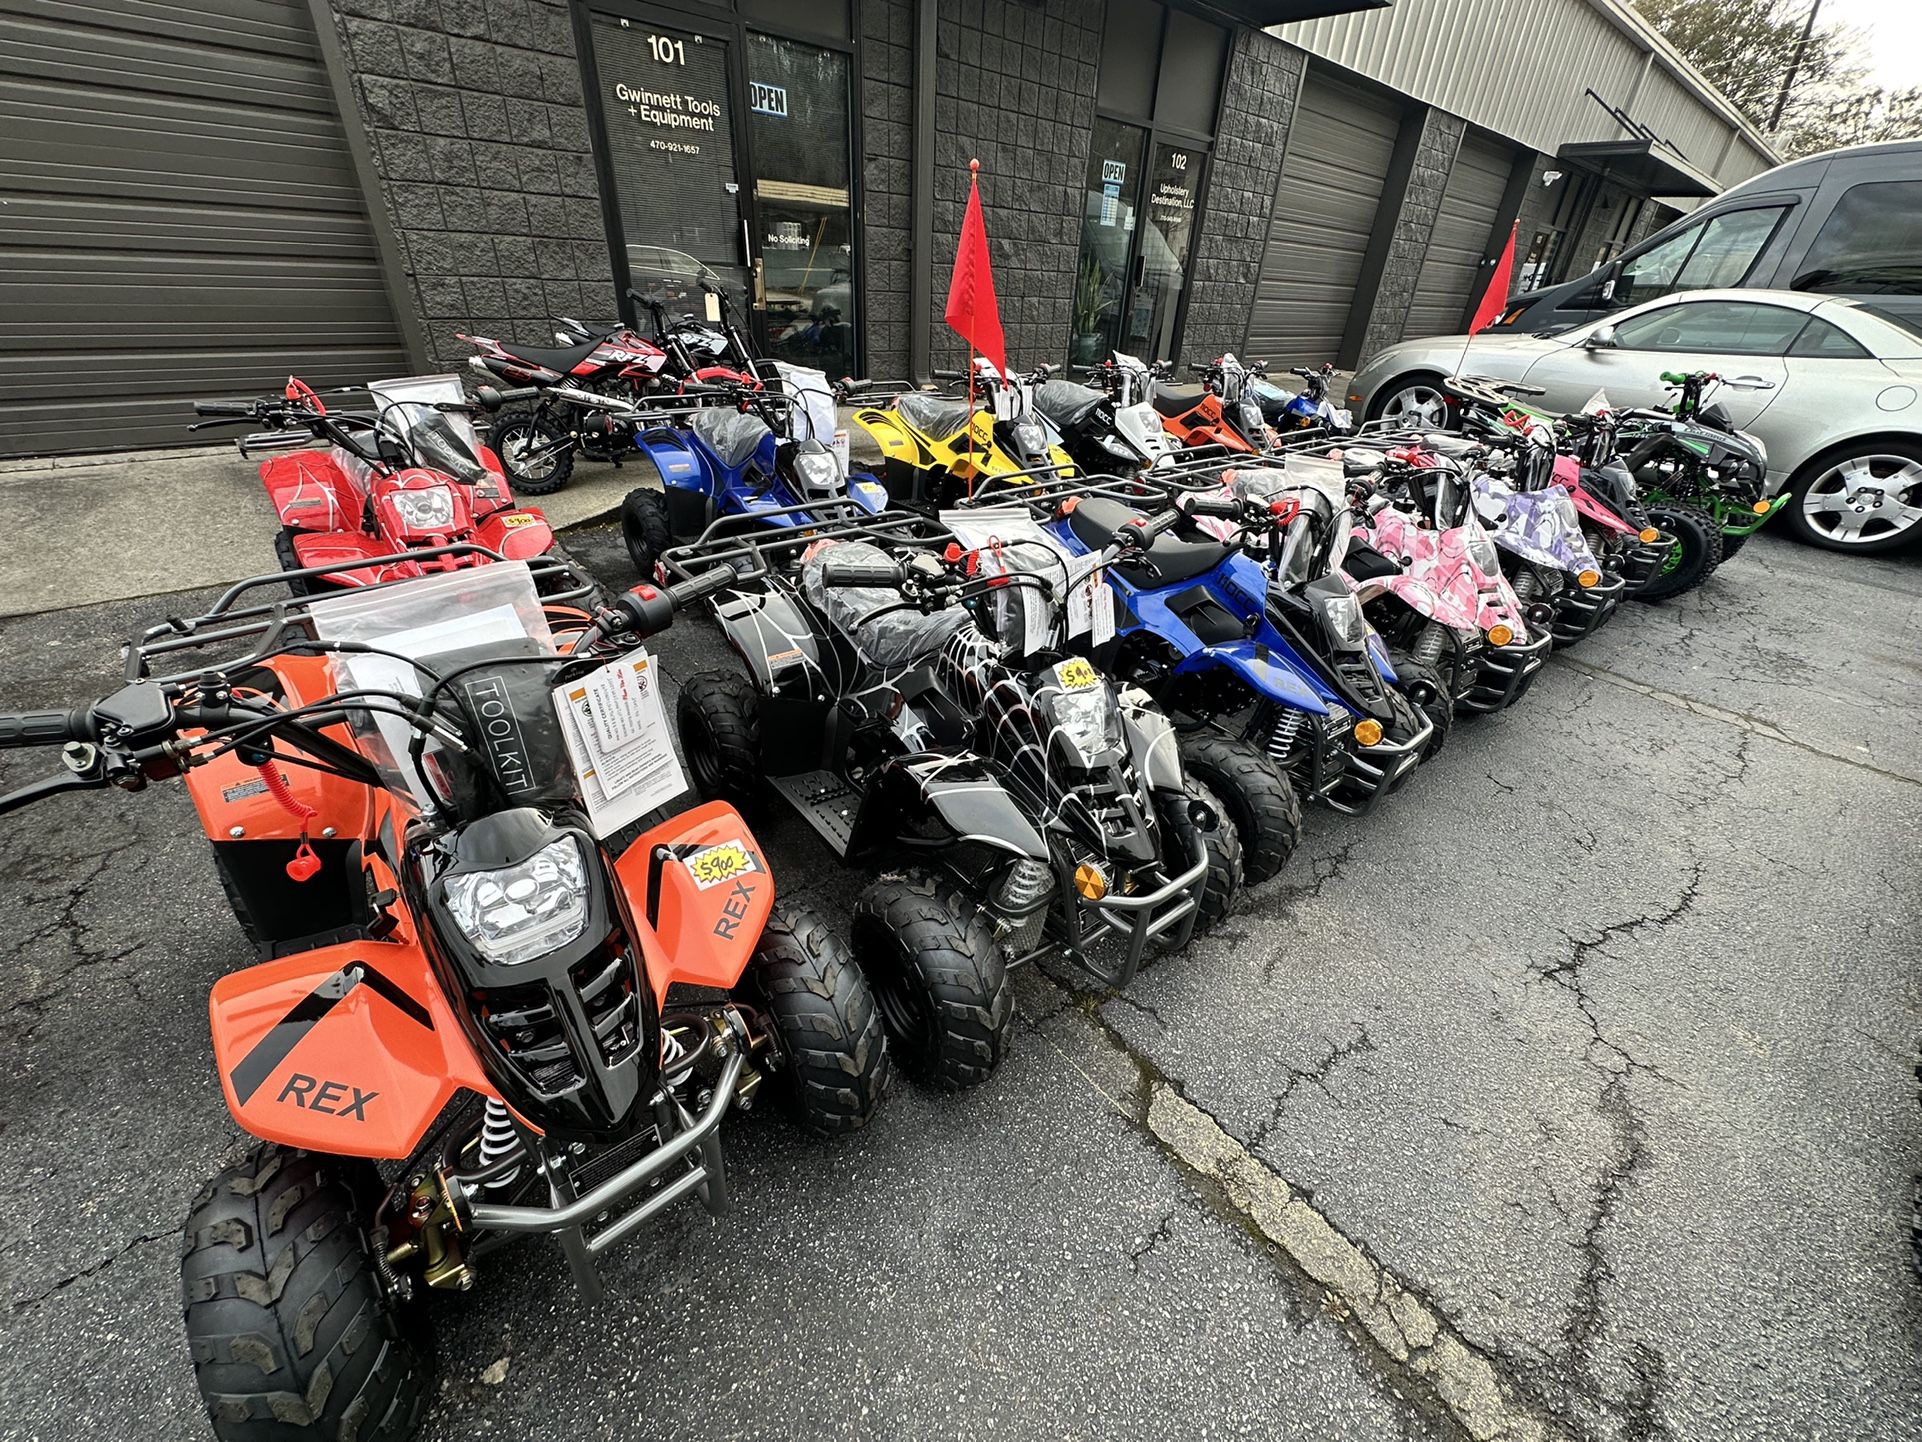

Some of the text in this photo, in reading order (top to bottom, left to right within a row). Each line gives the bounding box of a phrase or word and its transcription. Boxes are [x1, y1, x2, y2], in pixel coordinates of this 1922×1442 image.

[647, 35, 685, 66] 101
[616, 84, 721, 117] Gwinnett Tools
[751, 84, 784, 113] OPEN
[628, 104, 714, 131] + Equipment
[650, 140, 700, 155] 470-921-1657
[1171, 153, 1187, 170] 102
[1104, 163, 1124, 181] OPEN
[1160, 183, 1189, 199] Upholstery
[1183, 198, 1194, 209] LLC
[768, 233, 810, 247] No Soliciting
[681, 333, 711, 347] RFZ
[609, 350, 645, 364] RFZ
[1113, 447, 1129, 457] REX
[476, 682, 528, 786] TOOLKIT
[700, 856, 733, 876] $900
[713, 880, 756, 940] REX
[277, 1072, 380, 1121] REX
